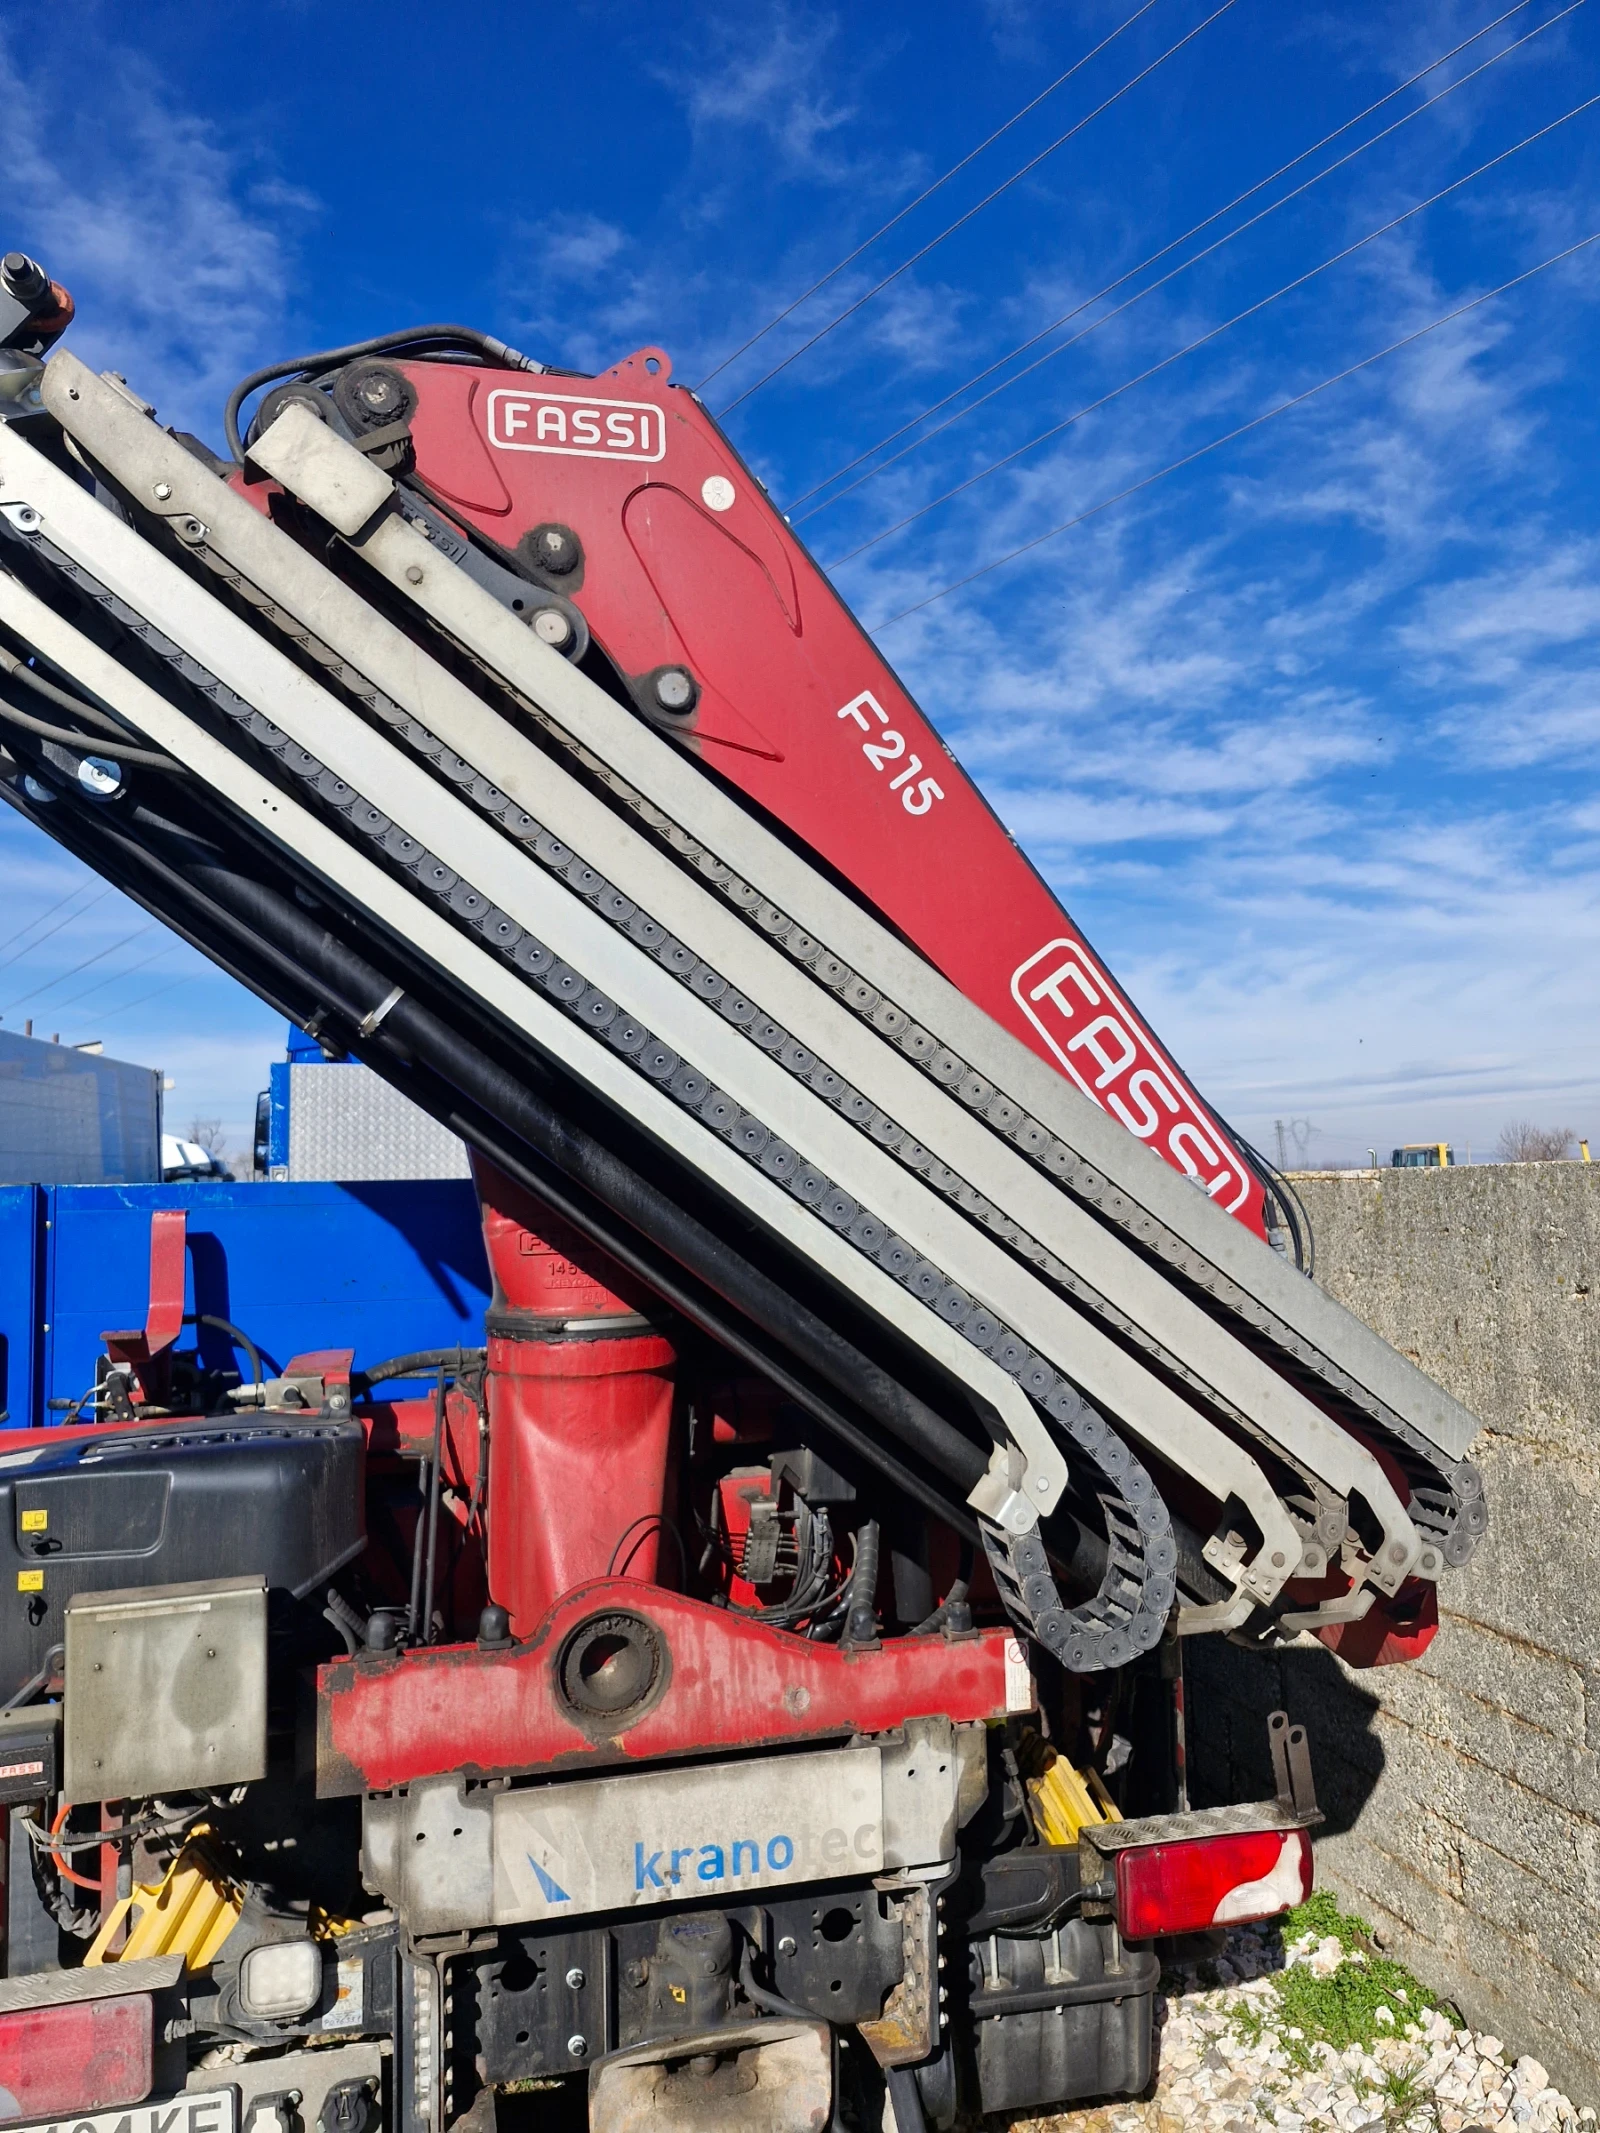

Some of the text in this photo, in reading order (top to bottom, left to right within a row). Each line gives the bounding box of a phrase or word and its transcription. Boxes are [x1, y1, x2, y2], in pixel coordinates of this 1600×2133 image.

[504, 402, 650, 450] FASSI
[837, 689, 945, 816] F215
[2, 1763, 40, 1776] FASSI
